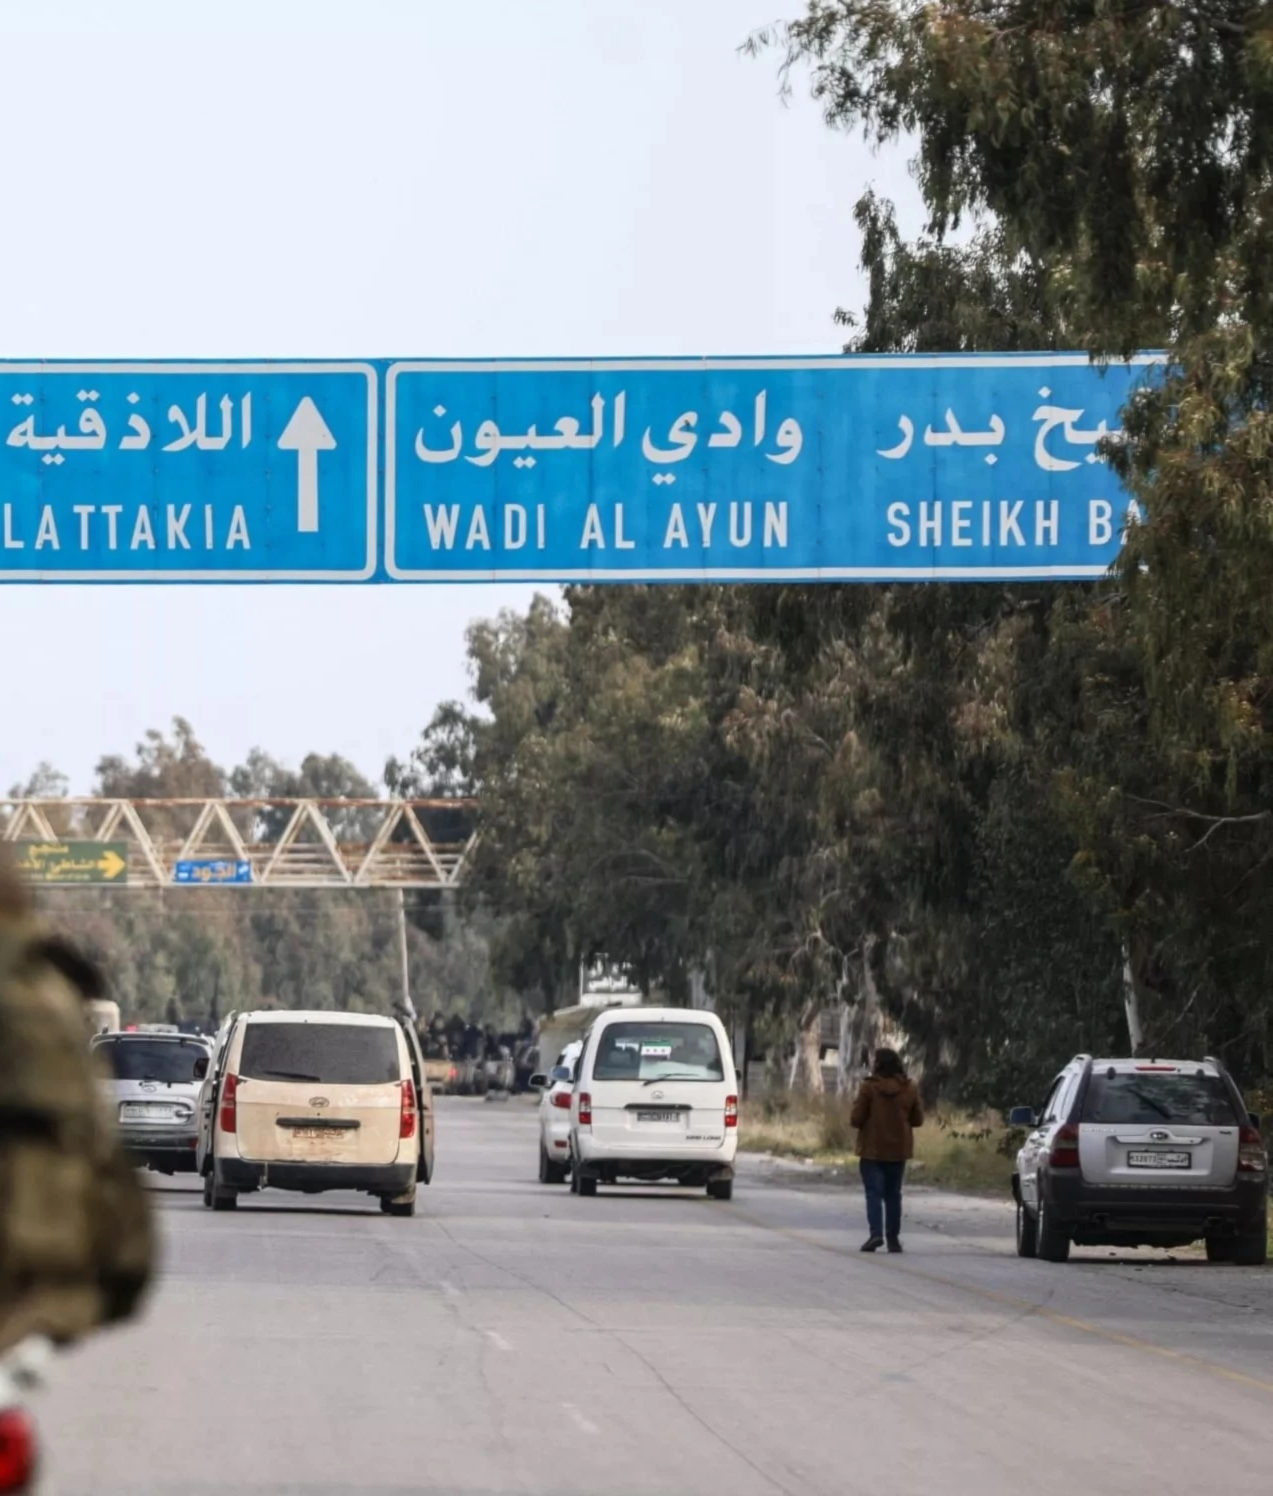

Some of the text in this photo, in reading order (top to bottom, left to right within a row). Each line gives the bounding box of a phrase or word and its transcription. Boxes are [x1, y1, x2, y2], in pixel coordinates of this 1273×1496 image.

[5, 390, 252, 466] اللاذقية
[414, 389, 804, 486] وادي العيون
[877, 397, 1006, 466] بدر
[3, 503, 251, 550] LATTAKIA
[423, 501, 789, 550] WADI AL AYUN
[886, 499, 1060, 547] SHEIKH
